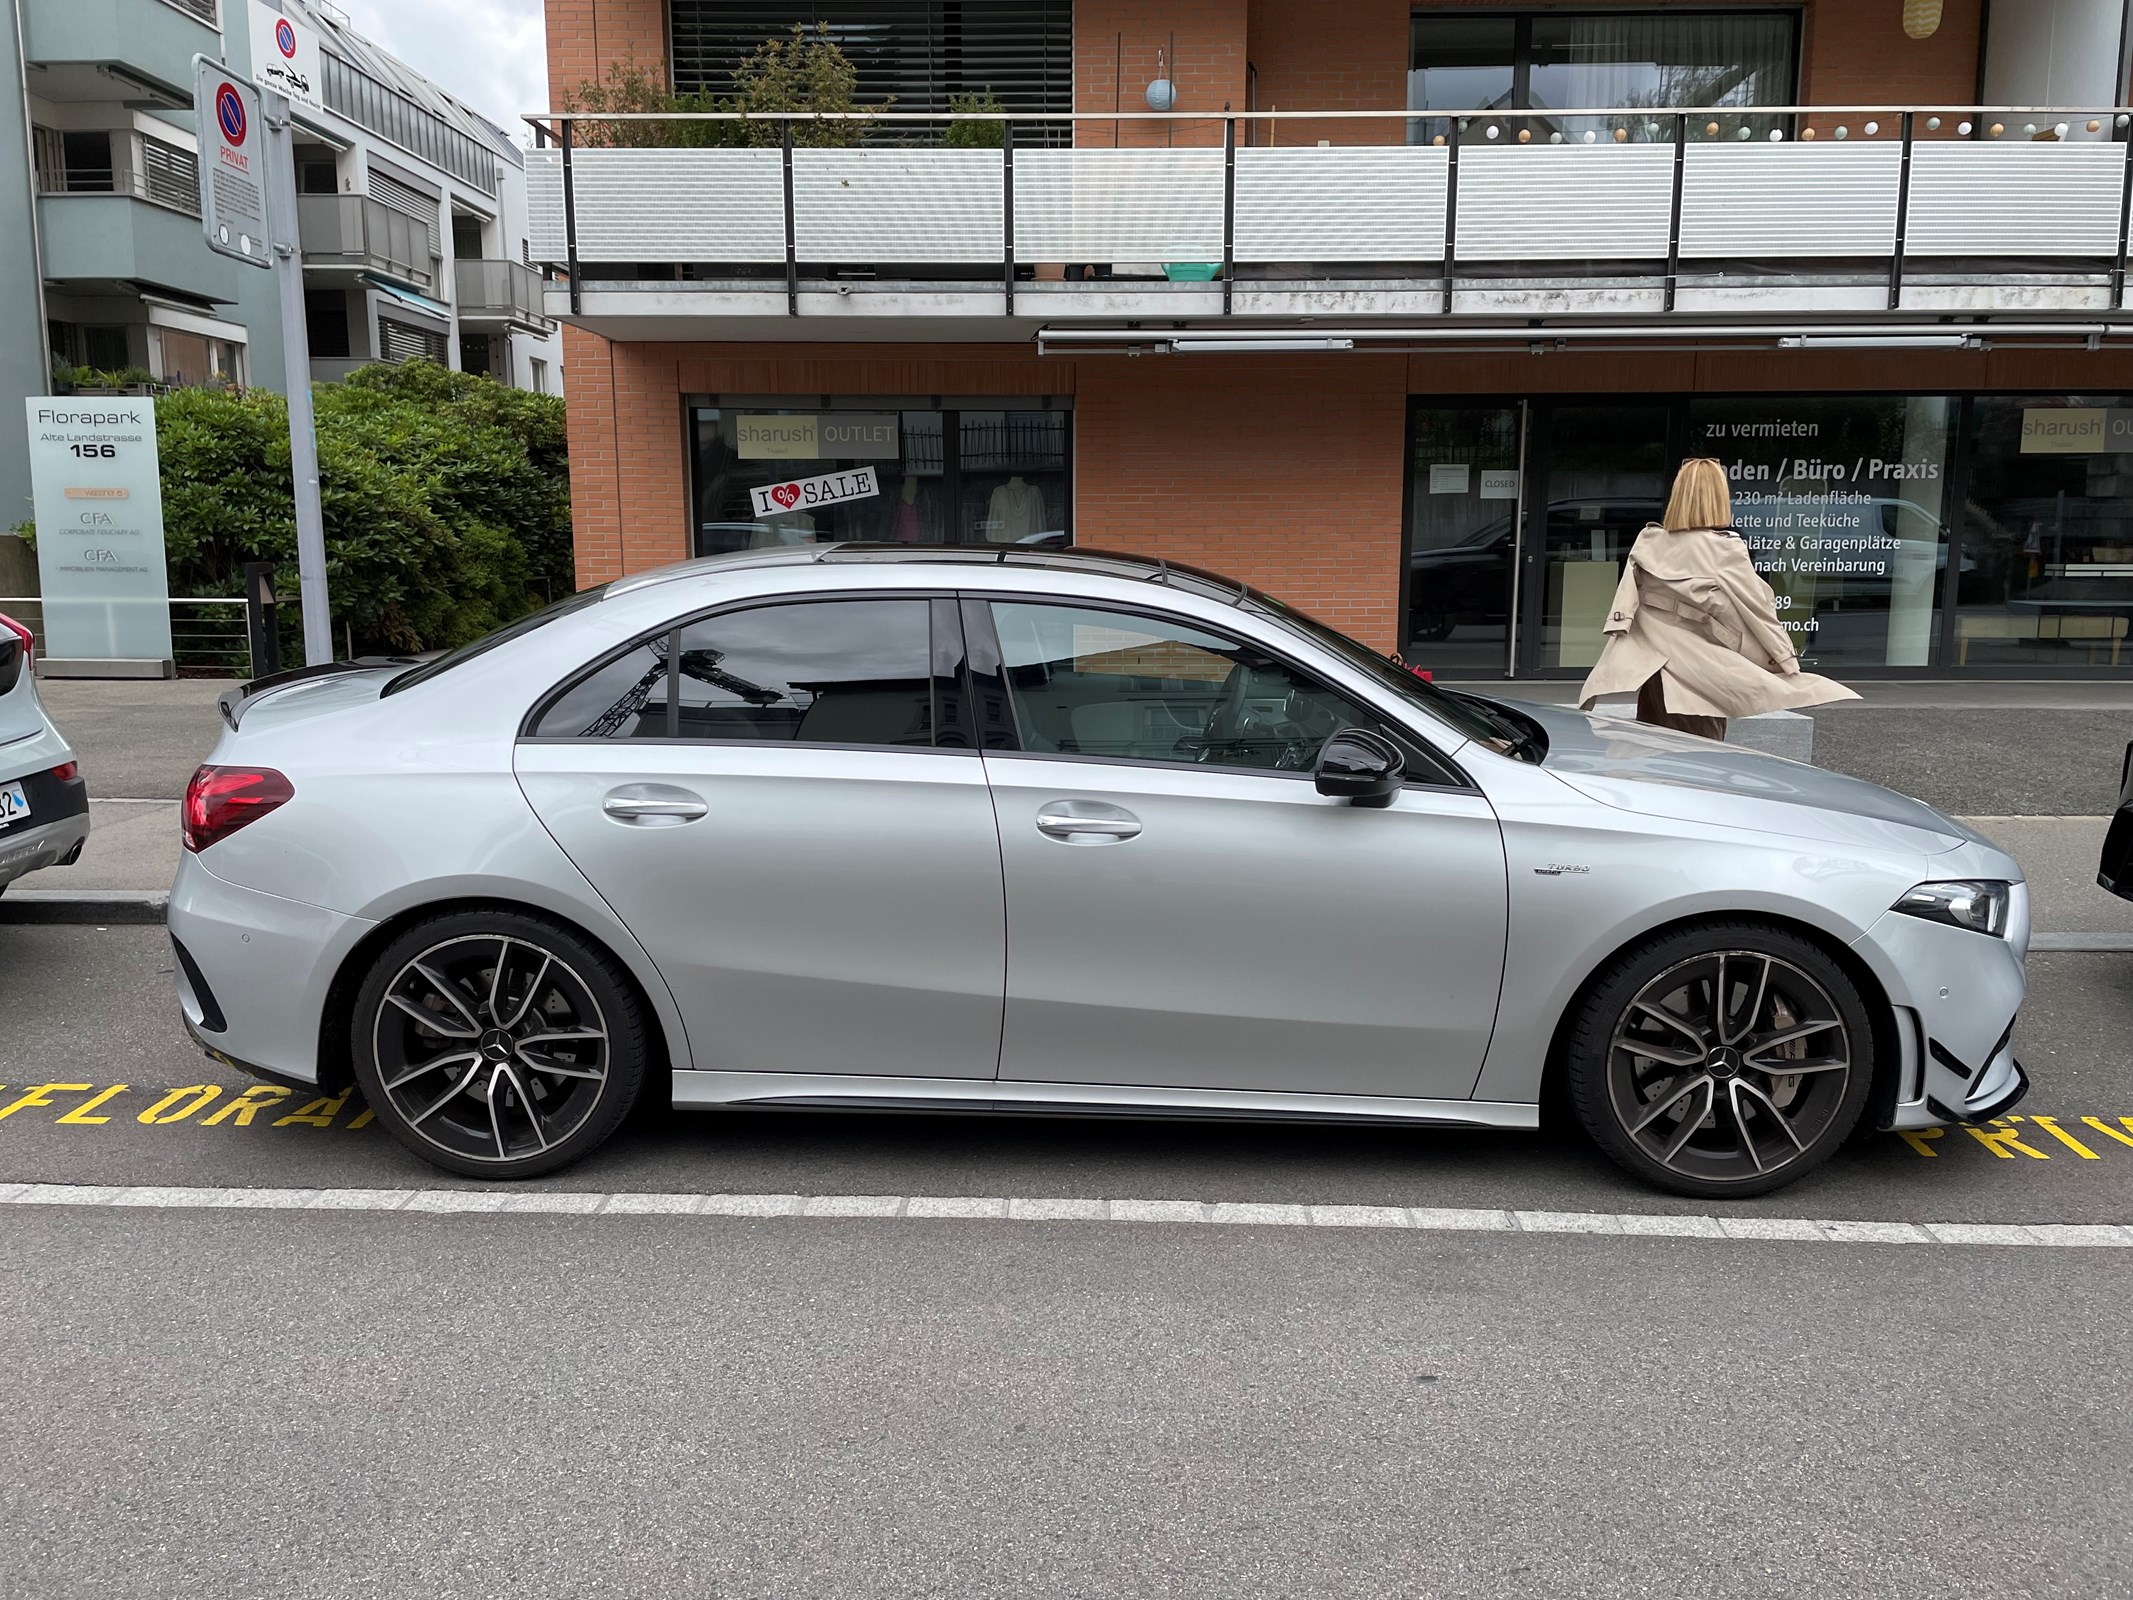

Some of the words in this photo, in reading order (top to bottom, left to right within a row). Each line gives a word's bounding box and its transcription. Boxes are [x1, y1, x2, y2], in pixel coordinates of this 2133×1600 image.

[220, 145, 249, 170] PRIVAT
[38, 409, 142, 427] Florapark
[824, 426, 894, 442] OUTLET
[1706, 424, 1726, 437] zu
[1731, 418, 1819, 437] vermieten
[40, 433, 65, 442] Alte
[66, 433, 143, 442] Landstrasse
[70, 444, 116, 458] 156
[1793, 459, 1846, 480] Büro
[1868, 458, 1939, 480] Praxis
[803, 472, 872, 505] SALE
[1484, 480, 1516, 488] CLOSED
[1734, 491, 1761, 505] 230
[1787, 490, 1872, 505] Ladenfläche
[80, 512, 113, 525] CFA
[1730, 513, 1762, 528] lette
[1765, 513, 1792, 528] und
[1796, 513, 1860, 528] Teeküche
[1785, 535, 1796, 550] &
[1800, 535, 1901, 553] Garagenplätze
[84, 549, 118, 561] CFA
[1754, 557, 1787, 572] nach
[1791, 557, 1886, 575] Vereinbarung
[1781, 617, 1819, 632] mo.ch
